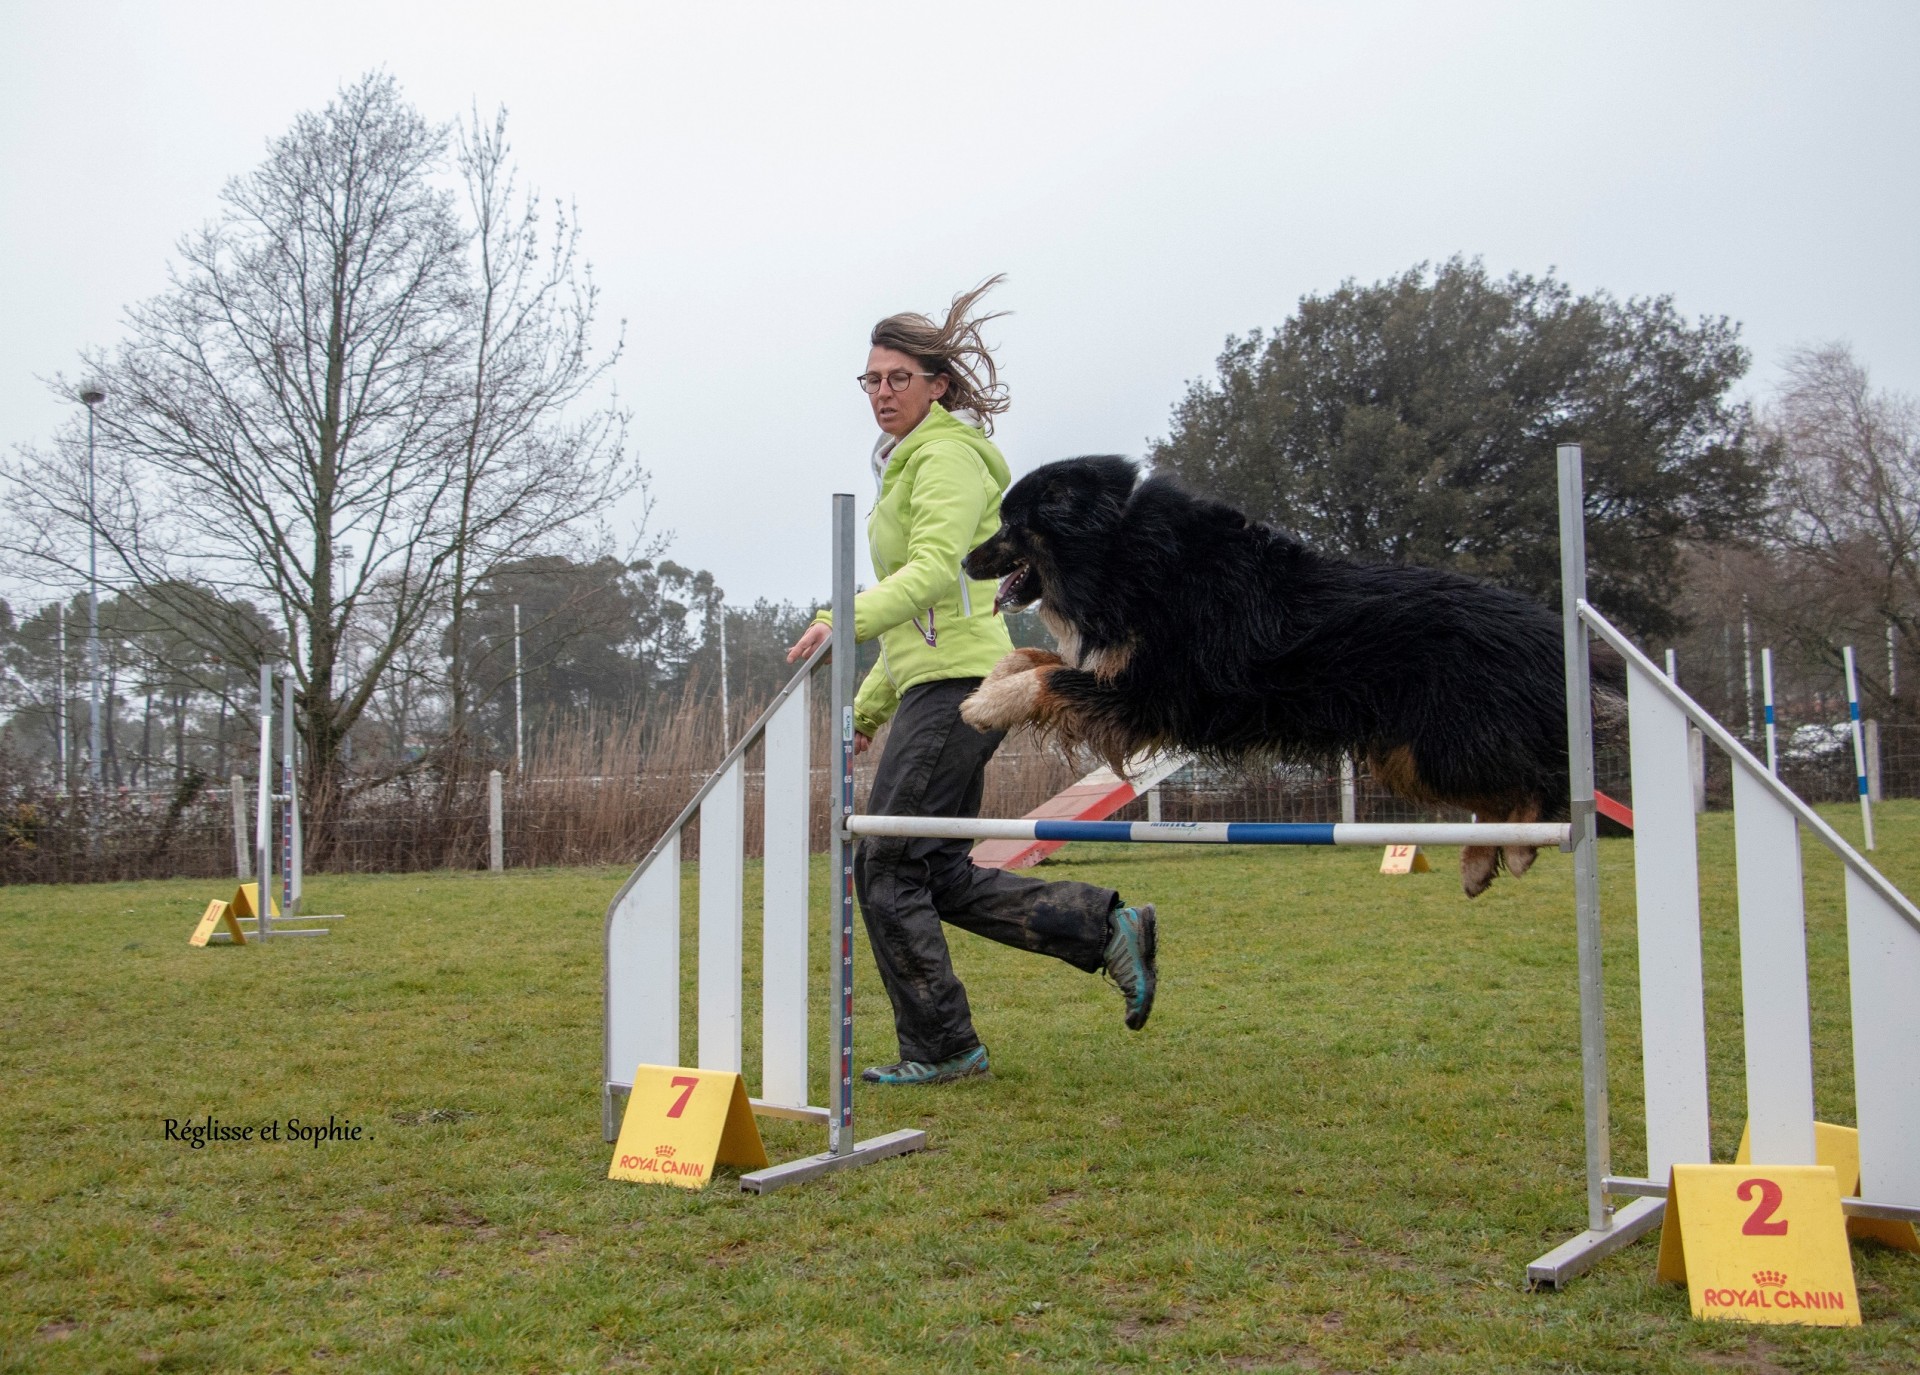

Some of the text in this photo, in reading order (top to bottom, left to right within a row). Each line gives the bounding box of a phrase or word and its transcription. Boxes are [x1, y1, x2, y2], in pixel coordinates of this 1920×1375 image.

[844, 746, 852, 754] 70
[844, 776, 852, 784] 65
[844, 806, 852, 814] 60
[1390, 846, 1408, 858] 12
[844, 866, 852, 874] 50
[844, 896, 852, 904] 45
[206, 904, 221, 922] 11
[844, 957, 852, 965] 35
[844, 987, 852, 995] 30
[844, 1017, 852, 1025] 25
[843, 1047, 852, 1055] 20
[843, 1077, 850, 1086] 15
[666, 1076, 700, 1119] 7
[843, 1107, 850, 1116] 10
[620, 1155, 704, 1178] ROYAL CANIN
[1736, 1178, 1788, 1236] 2
[1704, 1288, 1845, 1310] ROYAL CANIN
